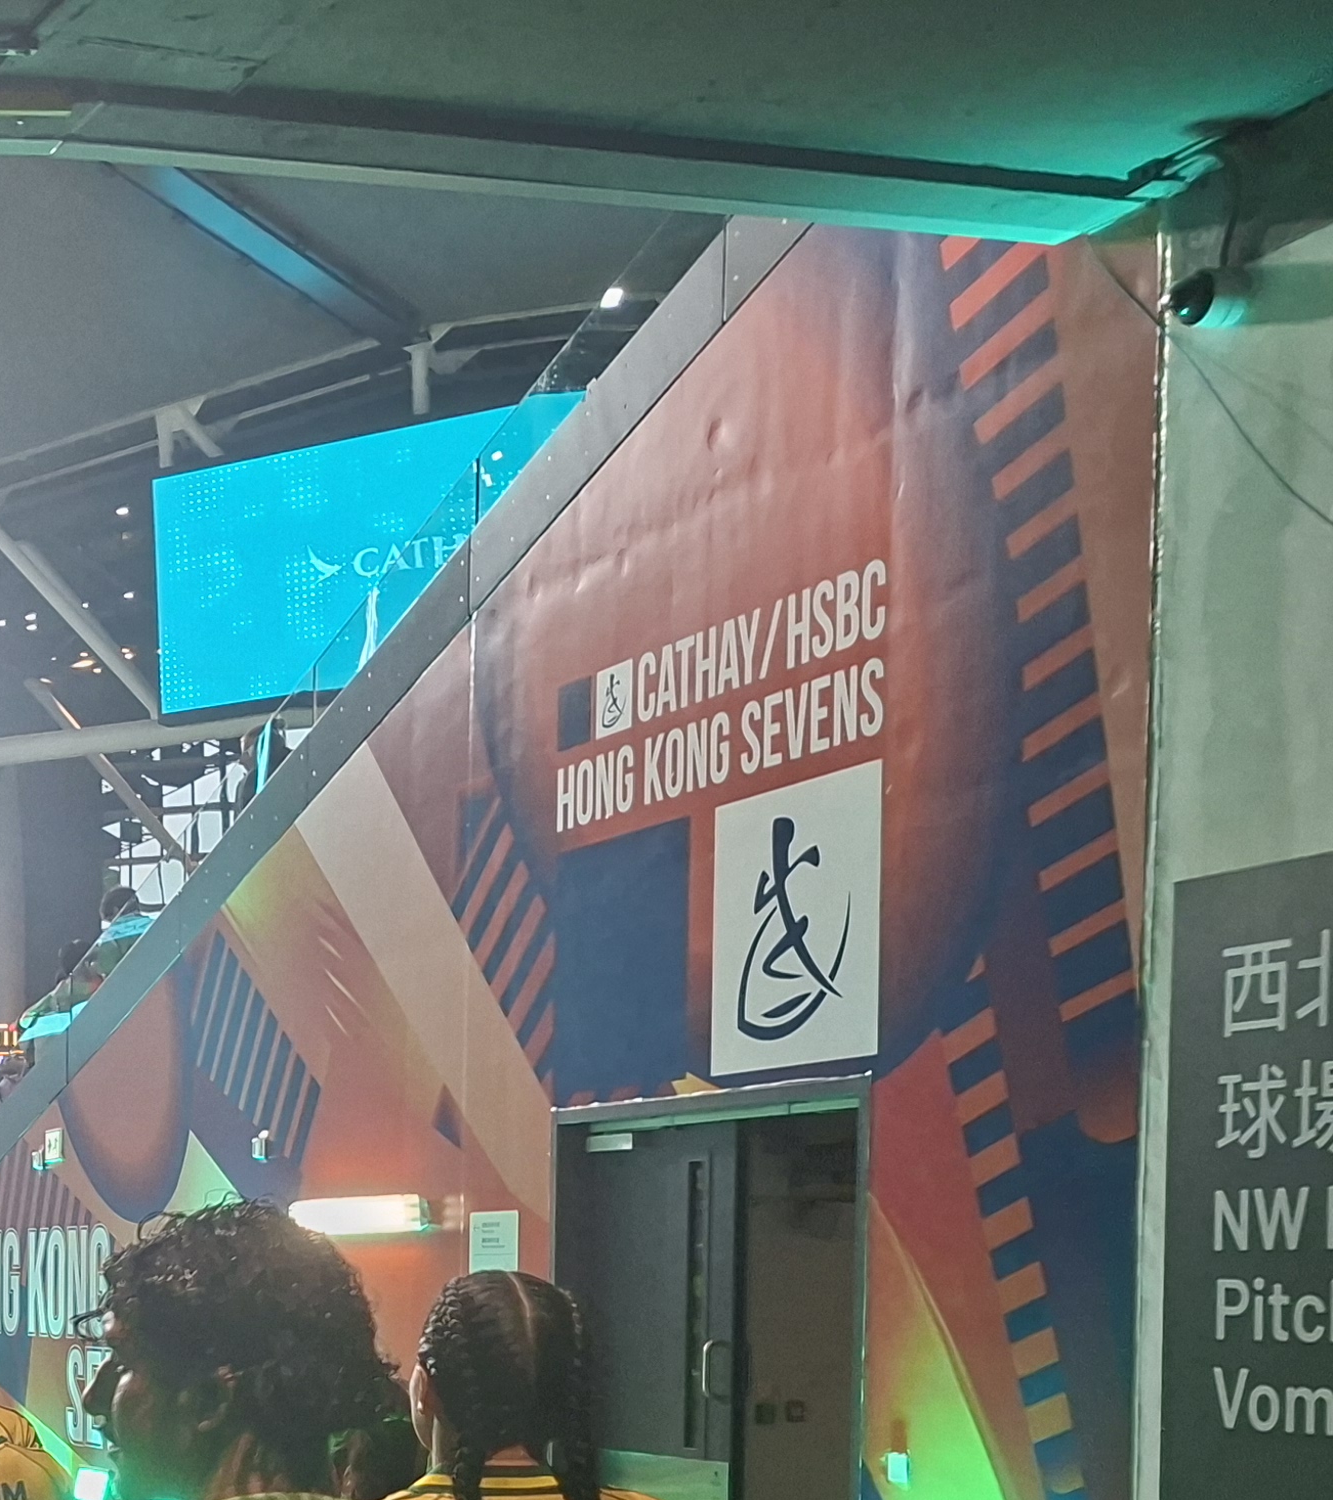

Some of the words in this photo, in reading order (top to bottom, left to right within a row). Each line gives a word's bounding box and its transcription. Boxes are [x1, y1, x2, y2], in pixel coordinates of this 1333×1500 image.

[637, 559, 887, 723] CATHAY/HSBC
[557, 745, 634, 832] HONG
[643, 711, 730, 805] KONG
[740, 657, 885, 775] SEVENS
[1214, 1185, 1310, 1252] NW
[27, 1223, 113, 1341] KONG
[1215, 1277, 1333, 1345] Pitc
